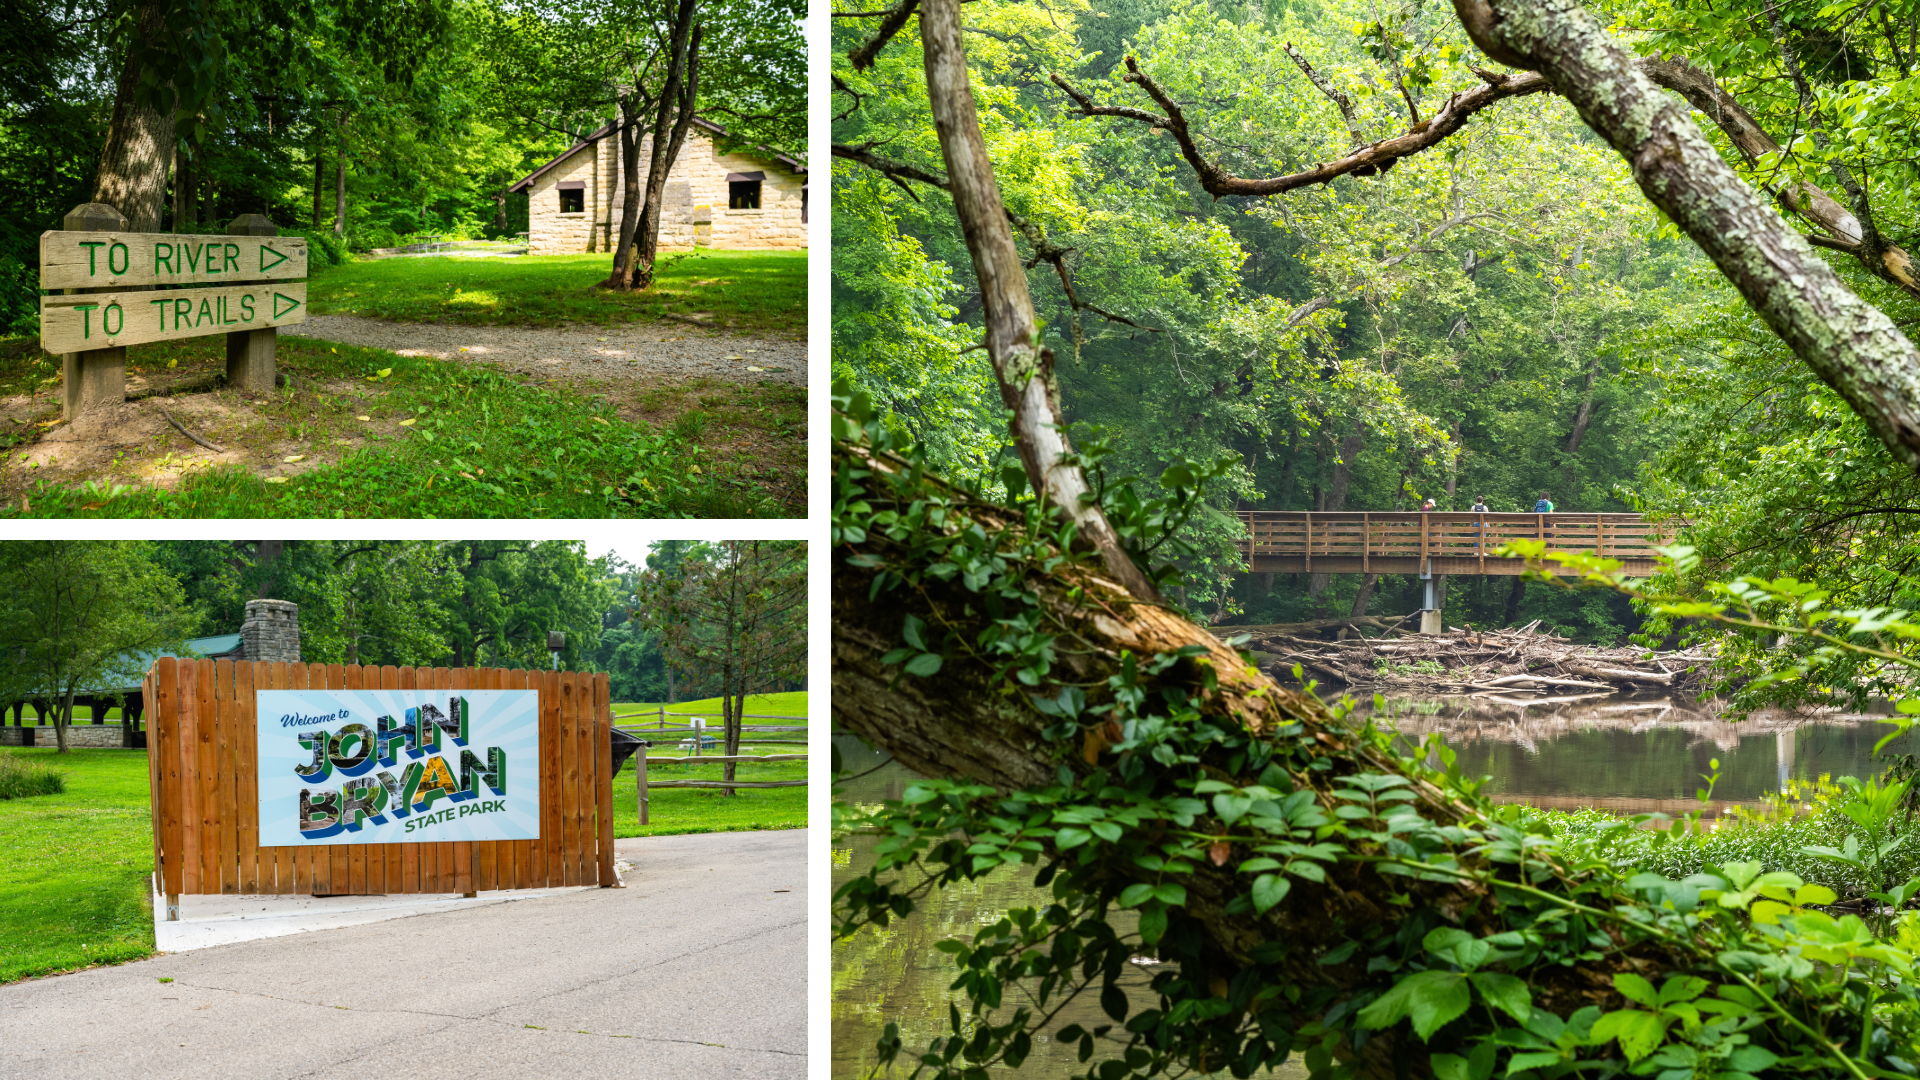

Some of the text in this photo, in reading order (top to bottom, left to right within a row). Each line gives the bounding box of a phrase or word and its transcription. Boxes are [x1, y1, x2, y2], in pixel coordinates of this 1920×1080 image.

[78, 241, 240, 277] TO RIVER
[73, 294, 256, 340] TO TRAILS
[280, 708, 350, 728] Welcome to
[294, 695, 469, 784] JOHN
[299, 746, 506, 840] BRYAN
[404, 799, 506, 833] STATE PARK
